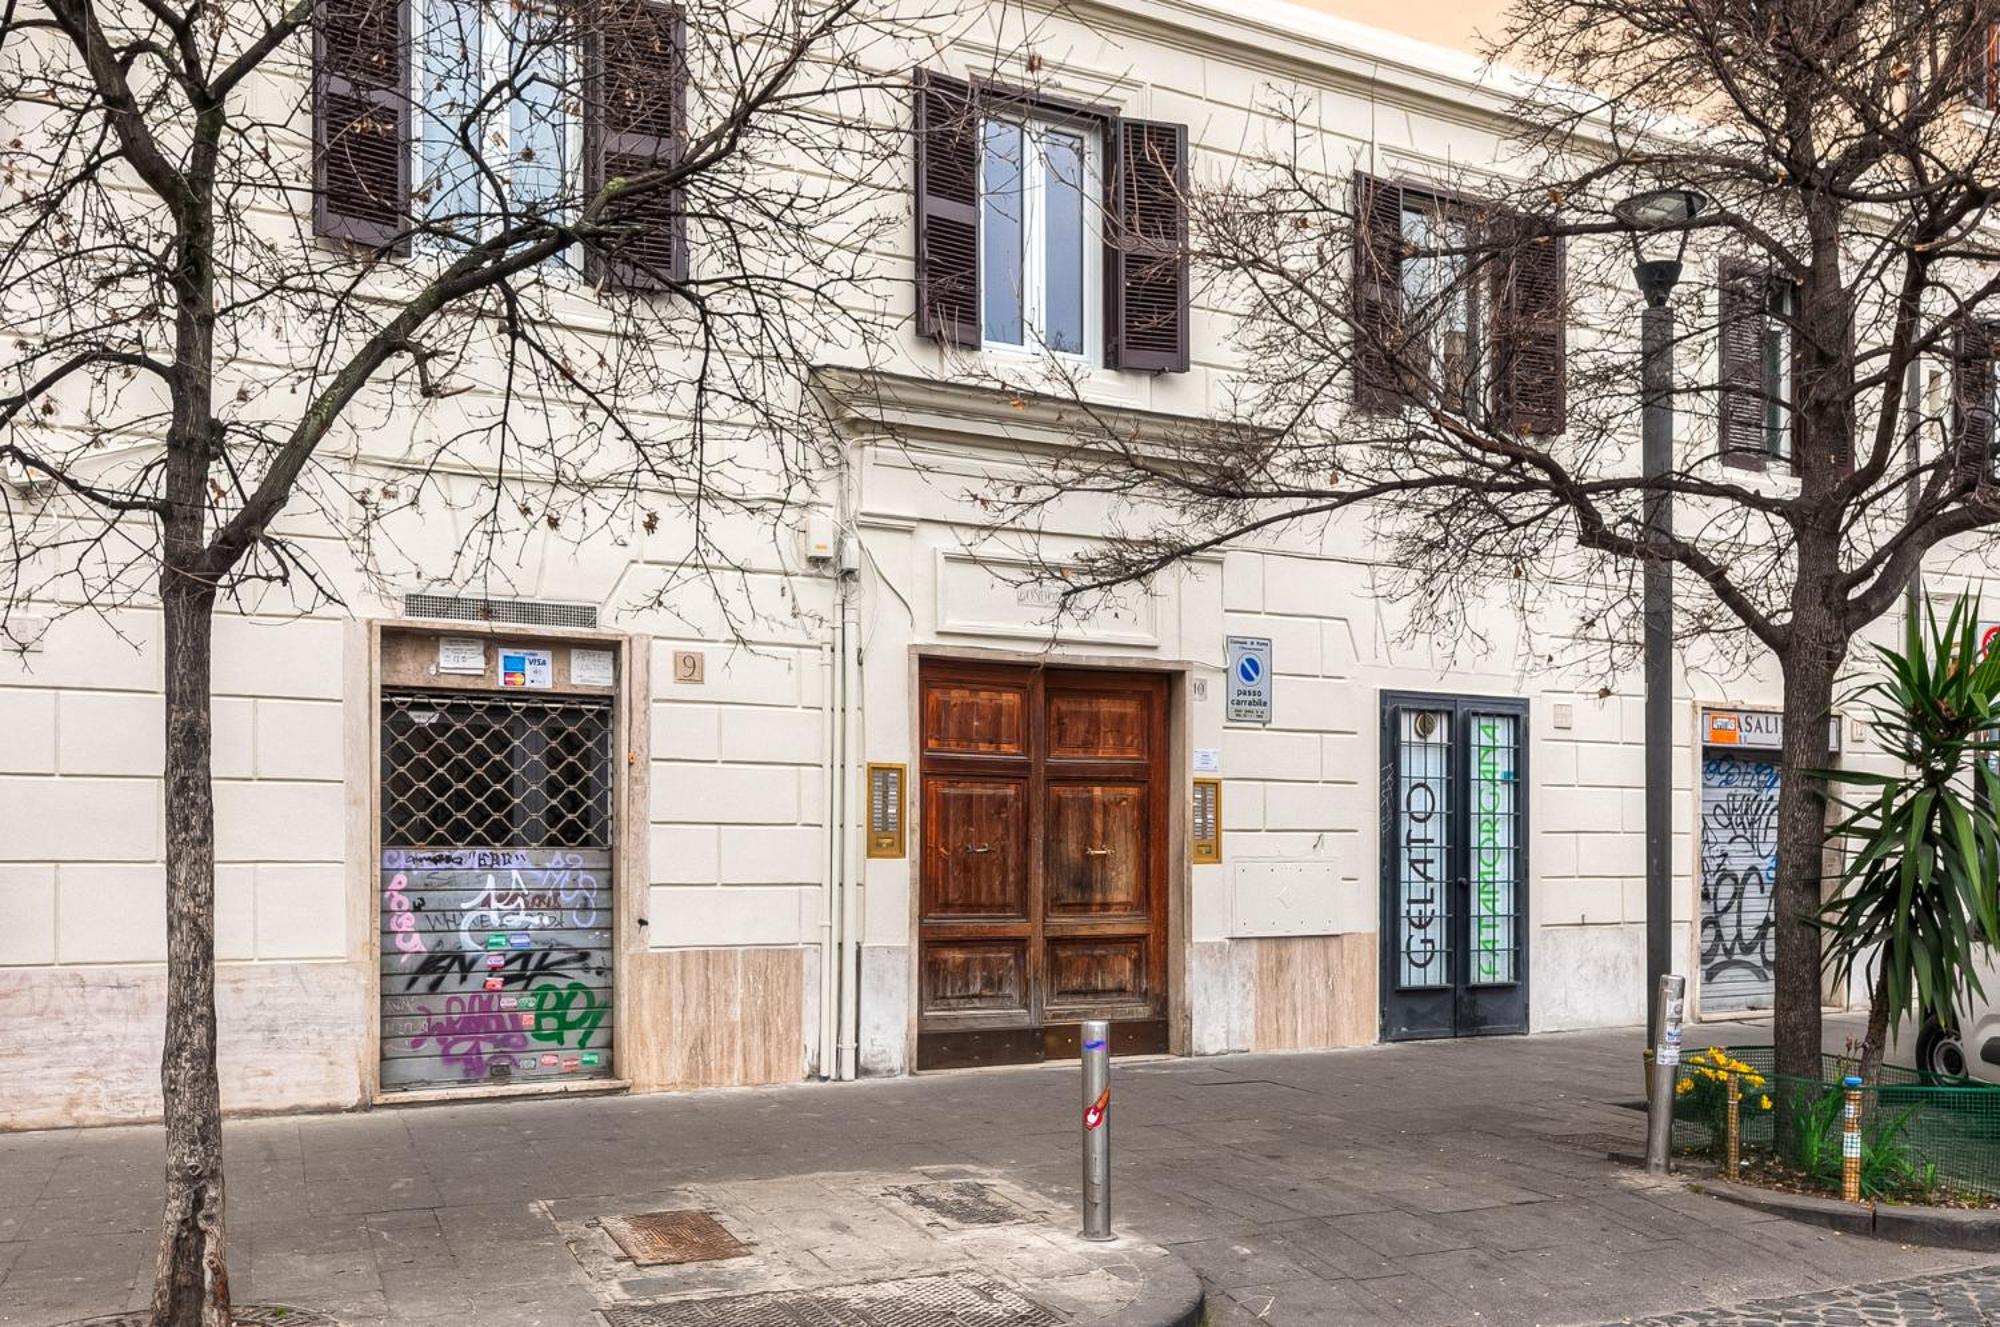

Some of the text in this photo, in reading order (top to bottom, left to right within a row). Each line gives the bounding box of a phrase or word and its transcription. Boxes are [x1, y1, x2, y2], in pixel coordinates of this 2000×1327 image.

[527, 658, 547, 666] VISA
[682, 655, 696, 678] 9
[1230, 698, 1268, 707] carrabile
[1236, 689, 1262, 697] passo
[1737, 715, 1784, 734] ASALI
[1479, 724, 1501, 977] FATAMORGANA
[1406, 782, 1436, 969] GELATO
